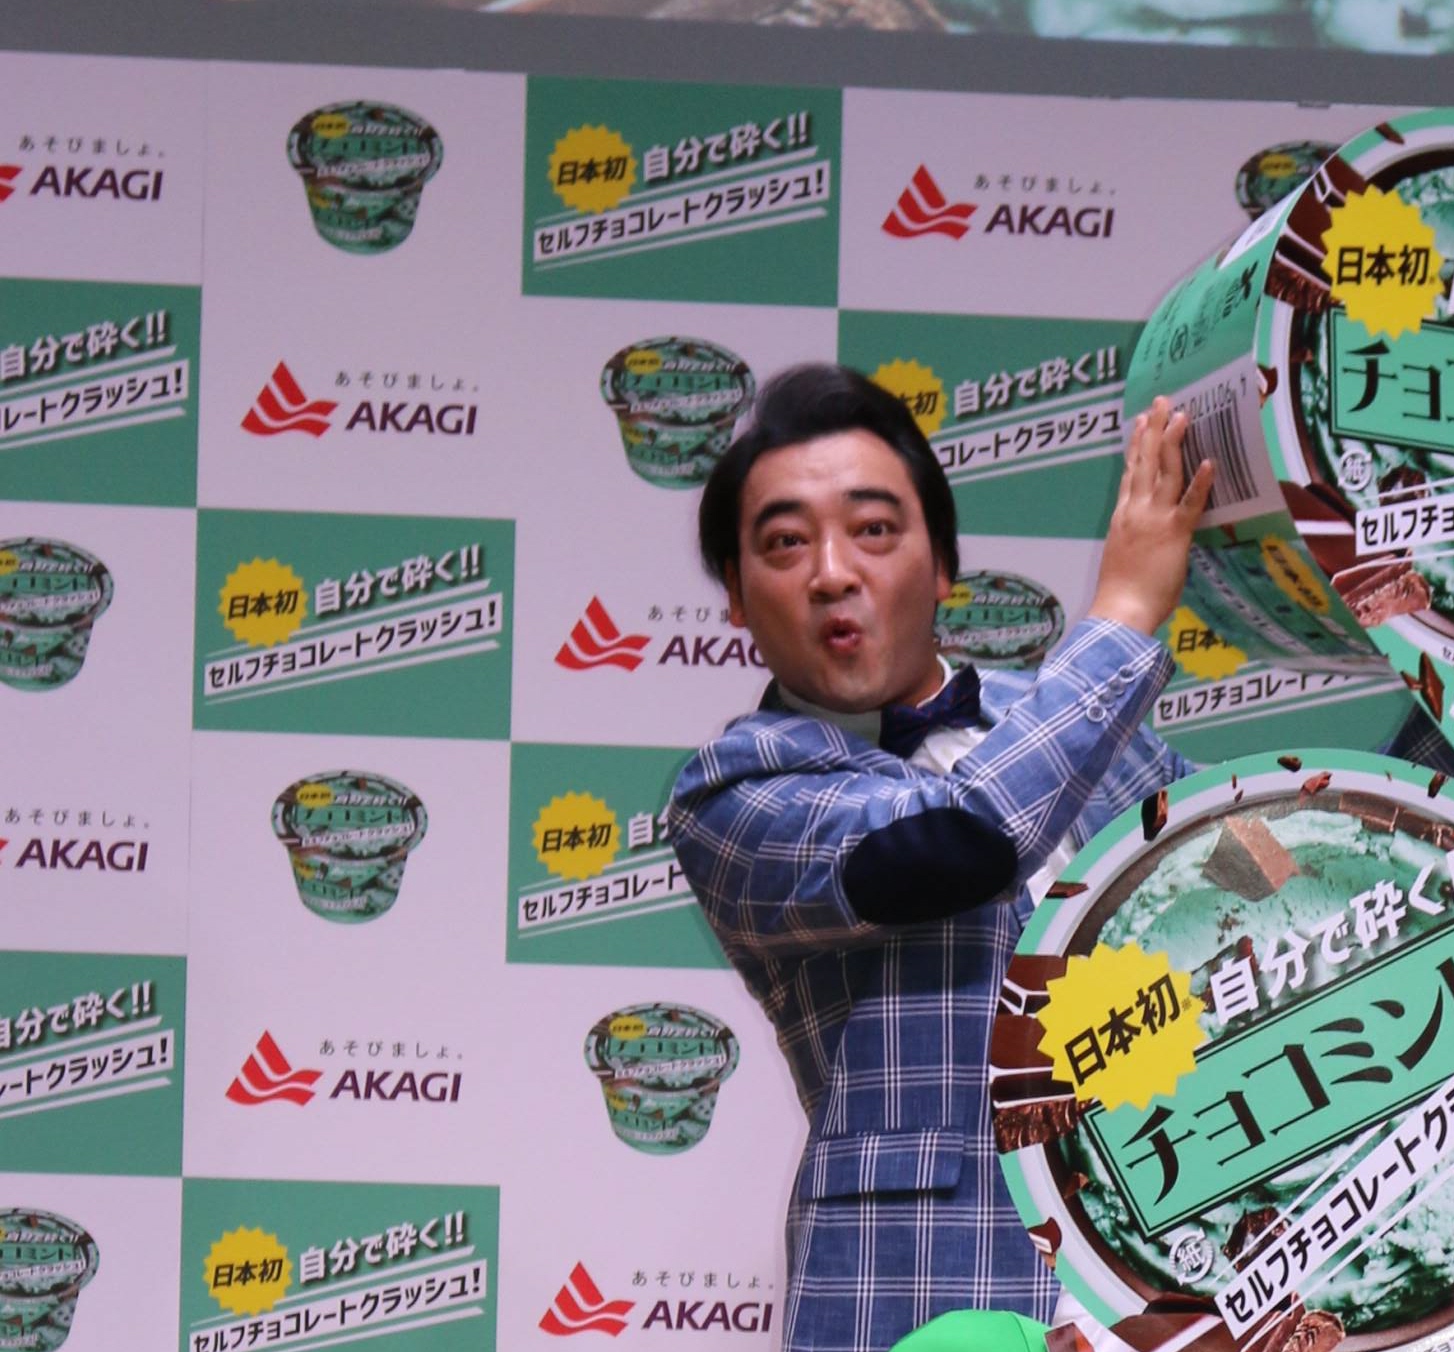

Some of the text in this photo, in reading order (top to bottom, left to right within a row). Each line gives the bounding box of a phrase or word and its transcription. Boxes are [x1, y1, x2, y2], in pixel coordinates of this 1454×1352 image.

[26, 163, 162, 199] AKAGI
[556, 155, 627, 186] 日本初
[982, 204, 1115, 239] AKAGI
[0, 365, 181, 428] レートクラッシュ!
[343, 401, 478, 436] AKAGI
[227, 589, 299, 620] 日本初
[1176, 627, 1232, 653] 日本
[13, 836, 149, 871] AKAGI
[541, 823, 612, 854] 日本初
[0, 1036, 167, 1097] ートクラッシュ!
[328, 1069, 462, 1103] AKAGI
[212, 1257, 284, 1289] 日本初
[640, 1300, 774, 1333] AKAGI
